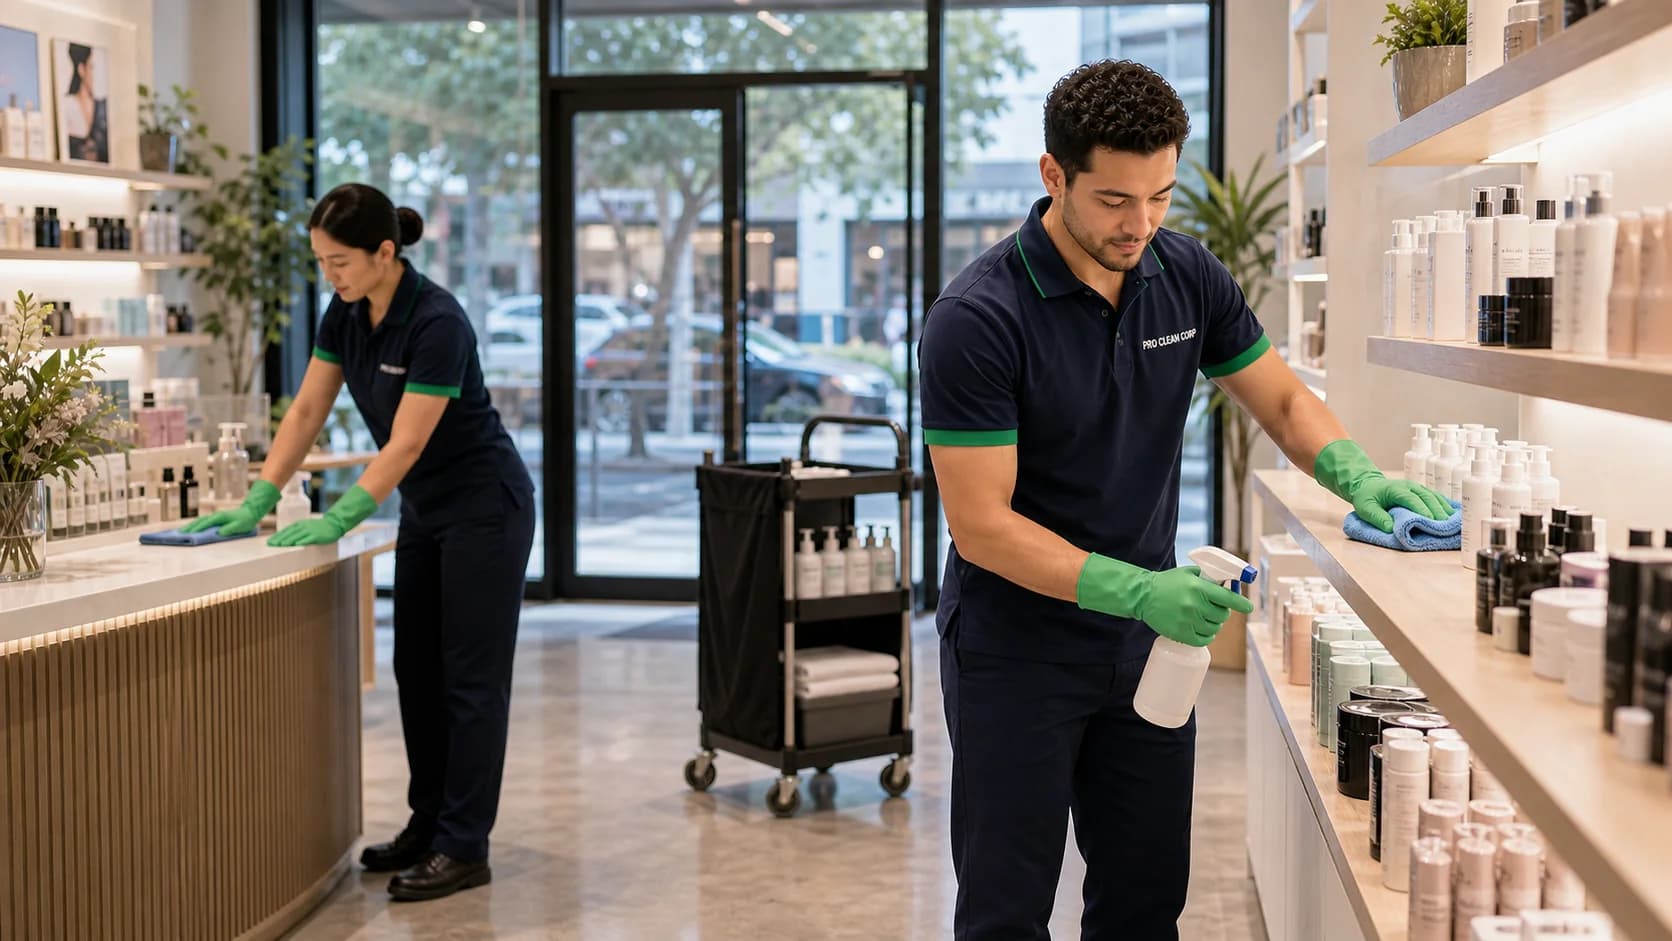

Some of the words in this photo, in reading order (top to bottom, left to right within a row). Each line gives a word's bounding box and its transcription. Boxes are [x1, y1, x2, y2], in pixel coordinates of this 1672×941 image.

[1142, 339, 1157, 350] PRO
[1158, 333, 1180, 346] CLEAN
[1180, 328, 1197, 341] CORP
